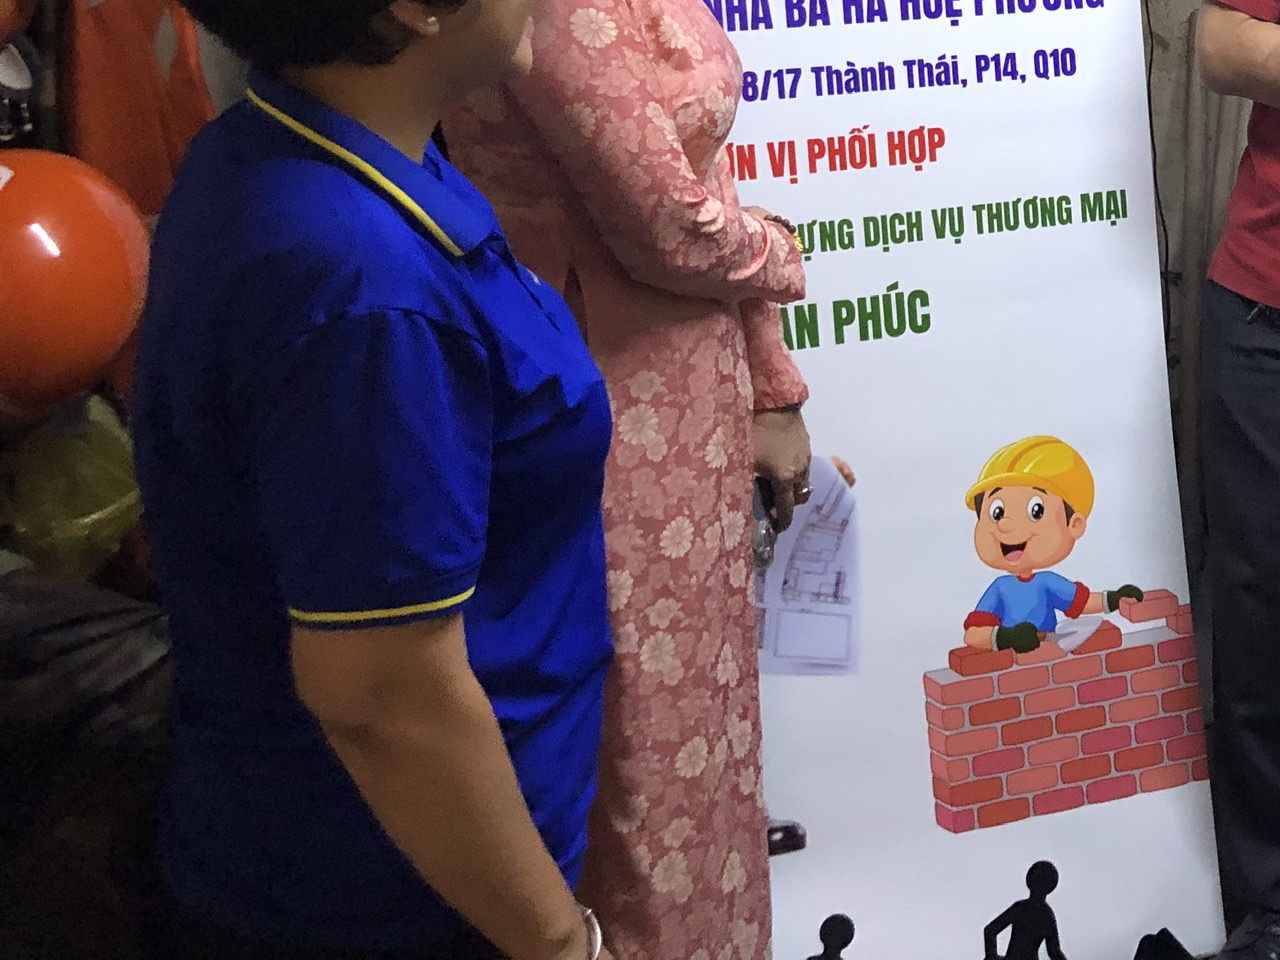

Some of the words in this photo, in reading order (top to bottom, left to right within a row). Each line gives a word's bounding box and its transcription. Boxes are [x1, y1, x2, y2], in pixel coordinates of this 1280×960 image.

[810, 61, 896, 97] Thành
[903, 53, 968, 88] Thái,
[975, 52, 1026, 83] P14,
[1033, 47, 1077, 80] Q10
[766, 140, 798, 184] VỊ
[807, 125, 878, 174] PHỐI
[887, 125, 945, 171] HỢP
[863, 210, 924, 253] DỊCH
[931, 206, 965, 244] VỤ
[972, 195, 1073, 235] THƯƠNG
[1079, 189, 1128, 227] MẠI
[832, 281, 931, 345] PHÚC
